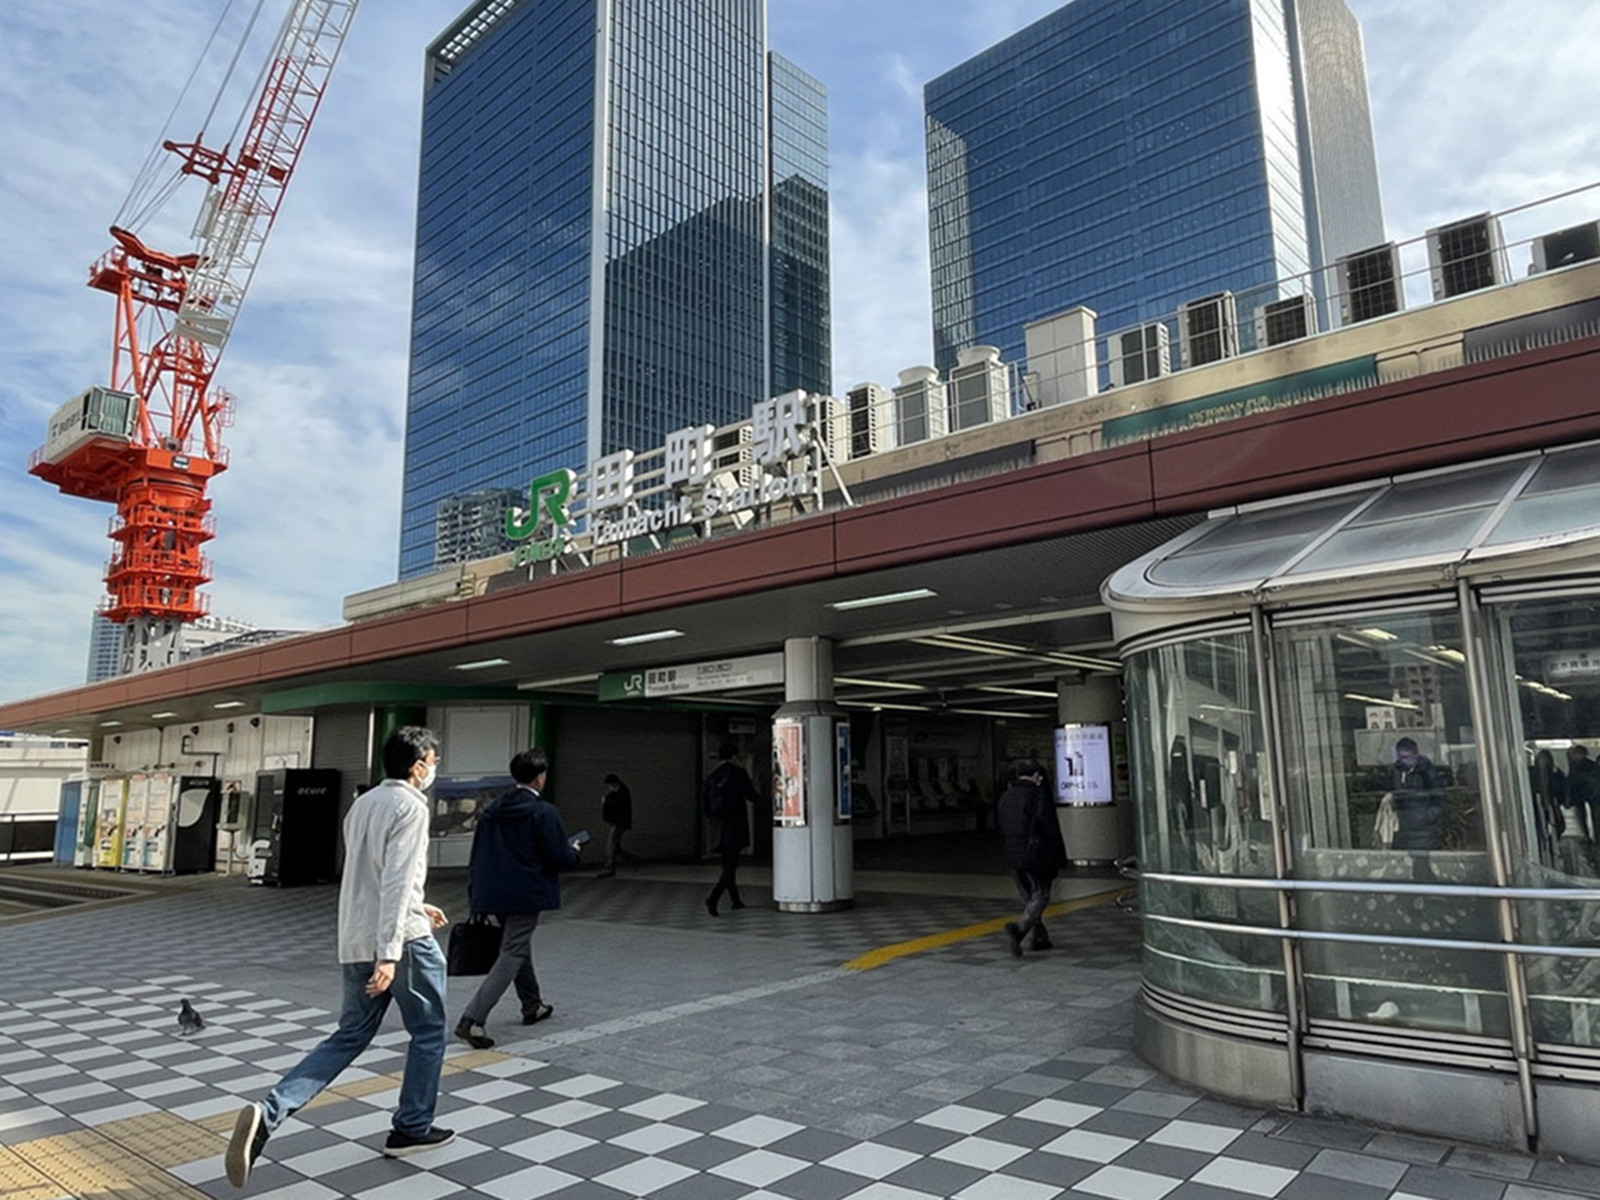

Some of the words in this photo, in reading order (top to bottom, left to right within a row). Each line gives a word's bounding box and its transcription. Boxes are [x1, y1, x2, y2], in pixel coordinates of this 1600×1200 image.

[592, 389, 806, 512] 田町駅
[505, 467, 576, 540] JR
[624, 674, 642, 691] JR
